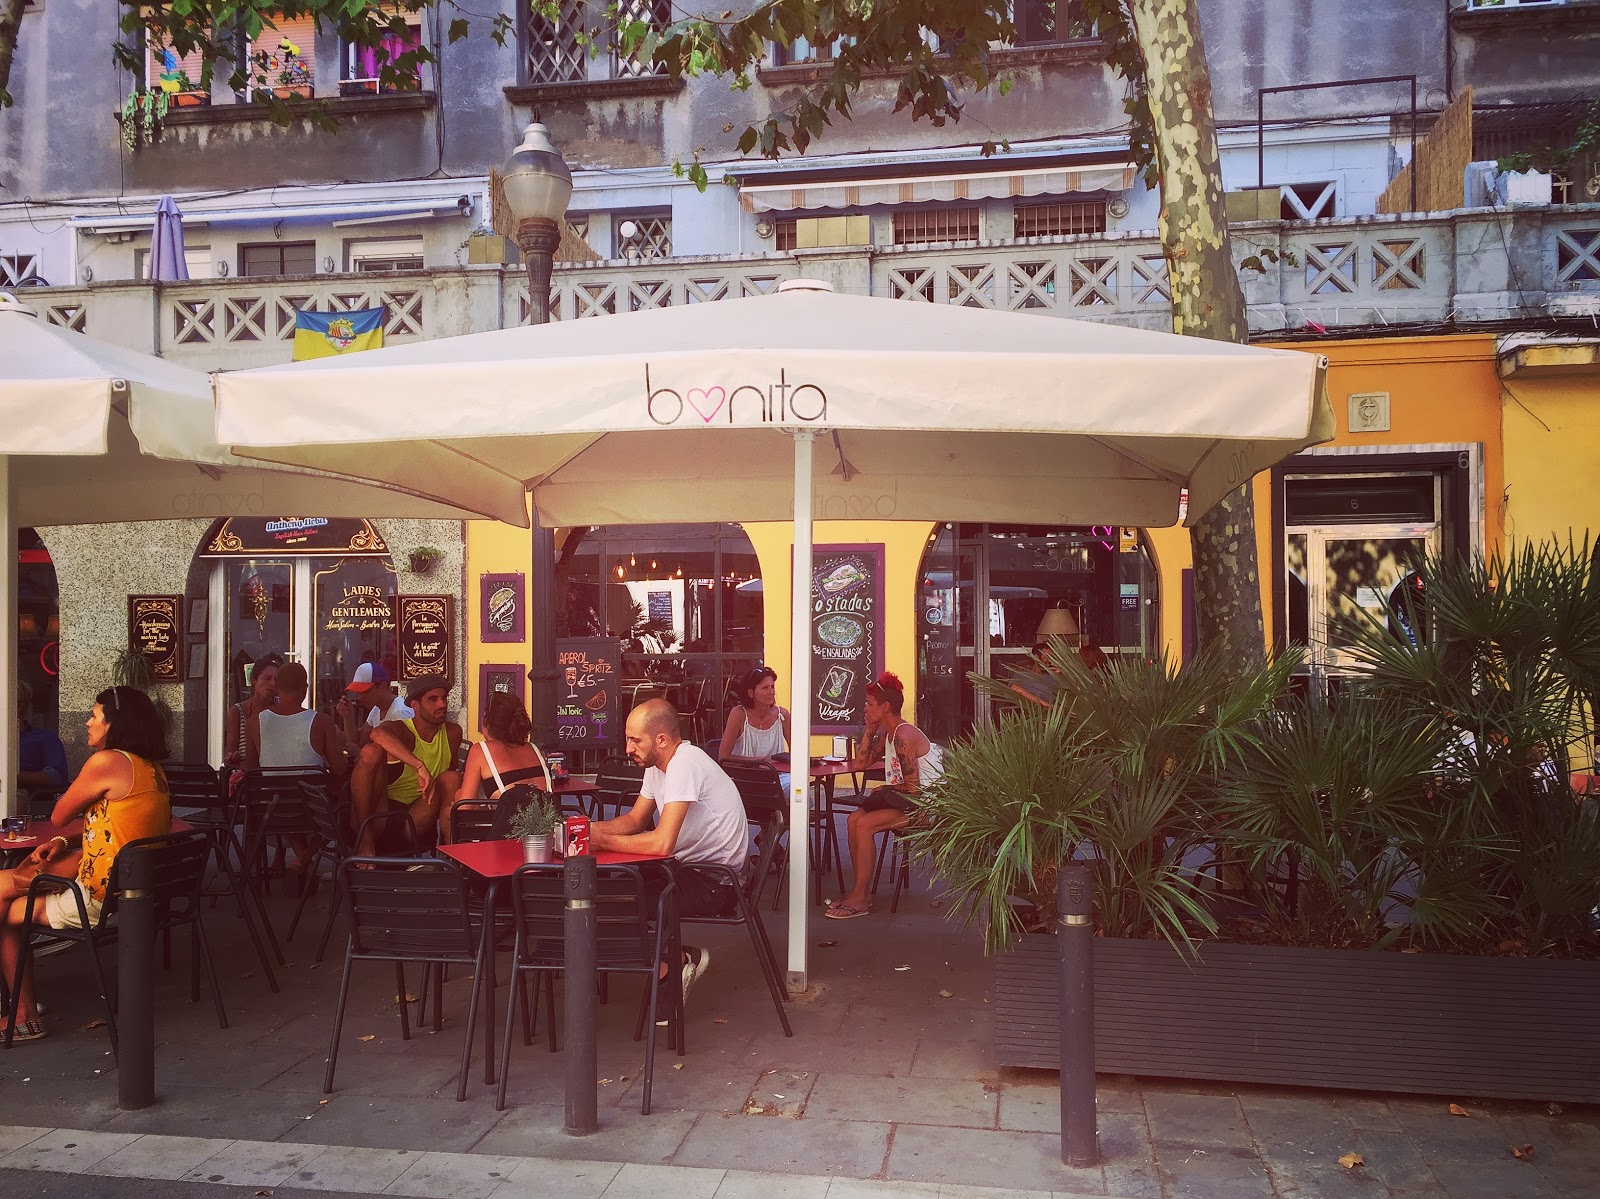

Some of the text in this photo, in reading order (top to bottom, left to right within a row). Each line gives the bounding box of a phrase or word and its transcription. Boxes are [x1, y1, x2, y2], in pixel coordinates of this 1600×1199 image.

[1457, 451, 1469, 469] 6
[1350, 498, 1359, 510] 6
[343, 585, 382, 597] LADIES
[811, 592, 873, 612] ostadas
[380, 619, 396, 631] Shop
[559, 652, 589, 664] APEROL
[821, 647, 857, 660] ENSALADAS
[580, 663, 613, 674] SPRITZ
[818, 702, 856, 721] Wraps
